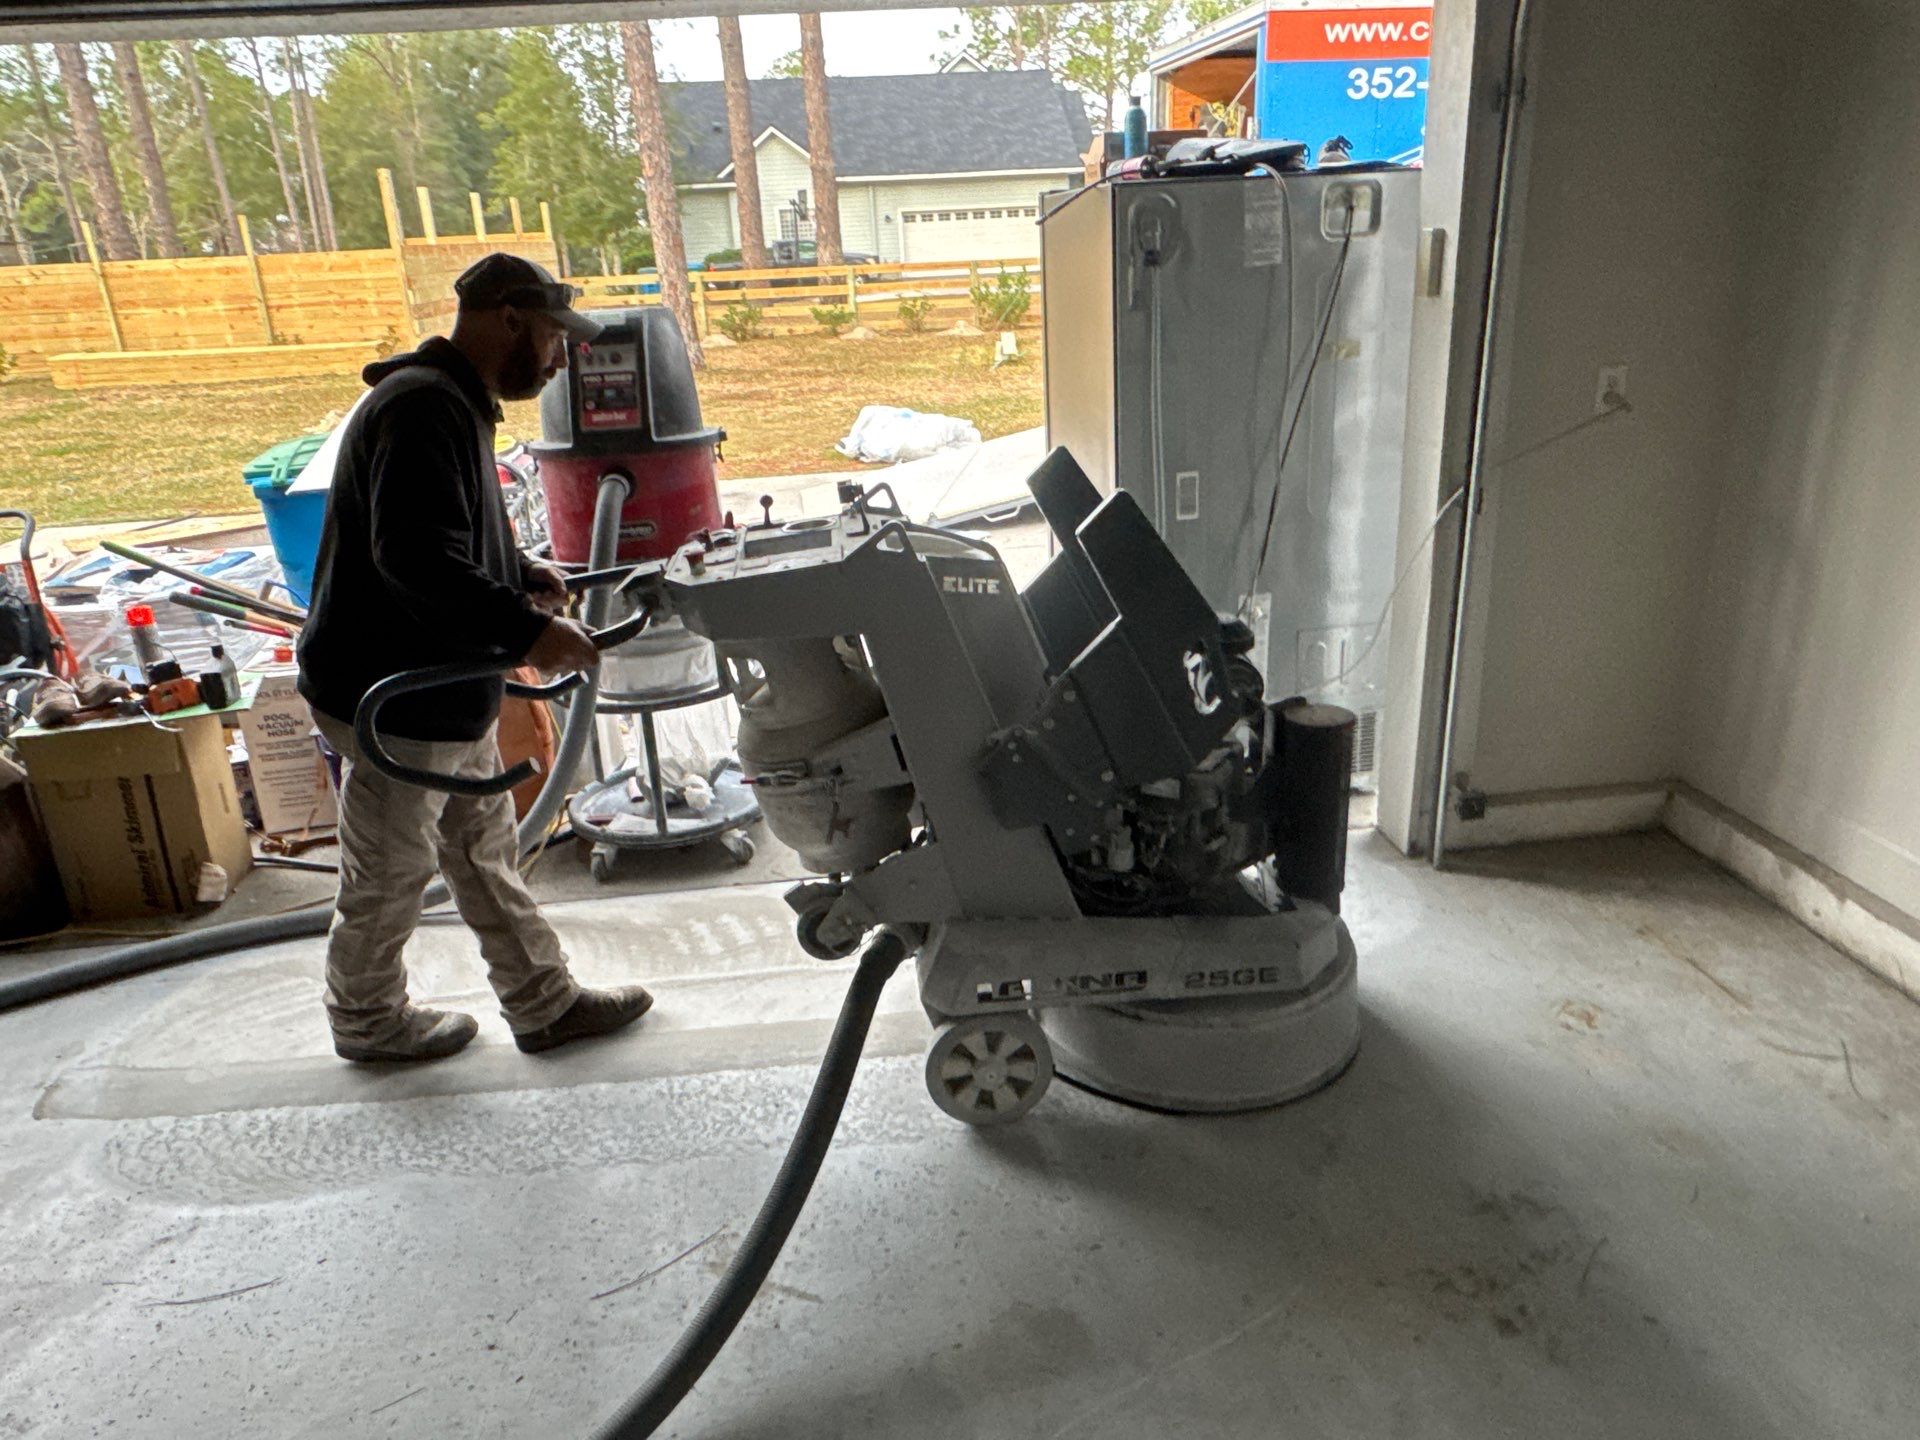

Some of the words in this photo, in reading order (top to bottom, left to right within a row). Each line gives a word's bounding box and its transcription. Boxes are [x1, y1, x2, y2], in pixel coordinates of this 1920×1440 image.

[1346, 66, 1429, 100] 352-
[943, 576, 1000, 594] ELITE
[263, 713, 294, 722] POOL
[257, 720, 304, 731] VACUUM
[267, 728, 296, 738] HOSE
